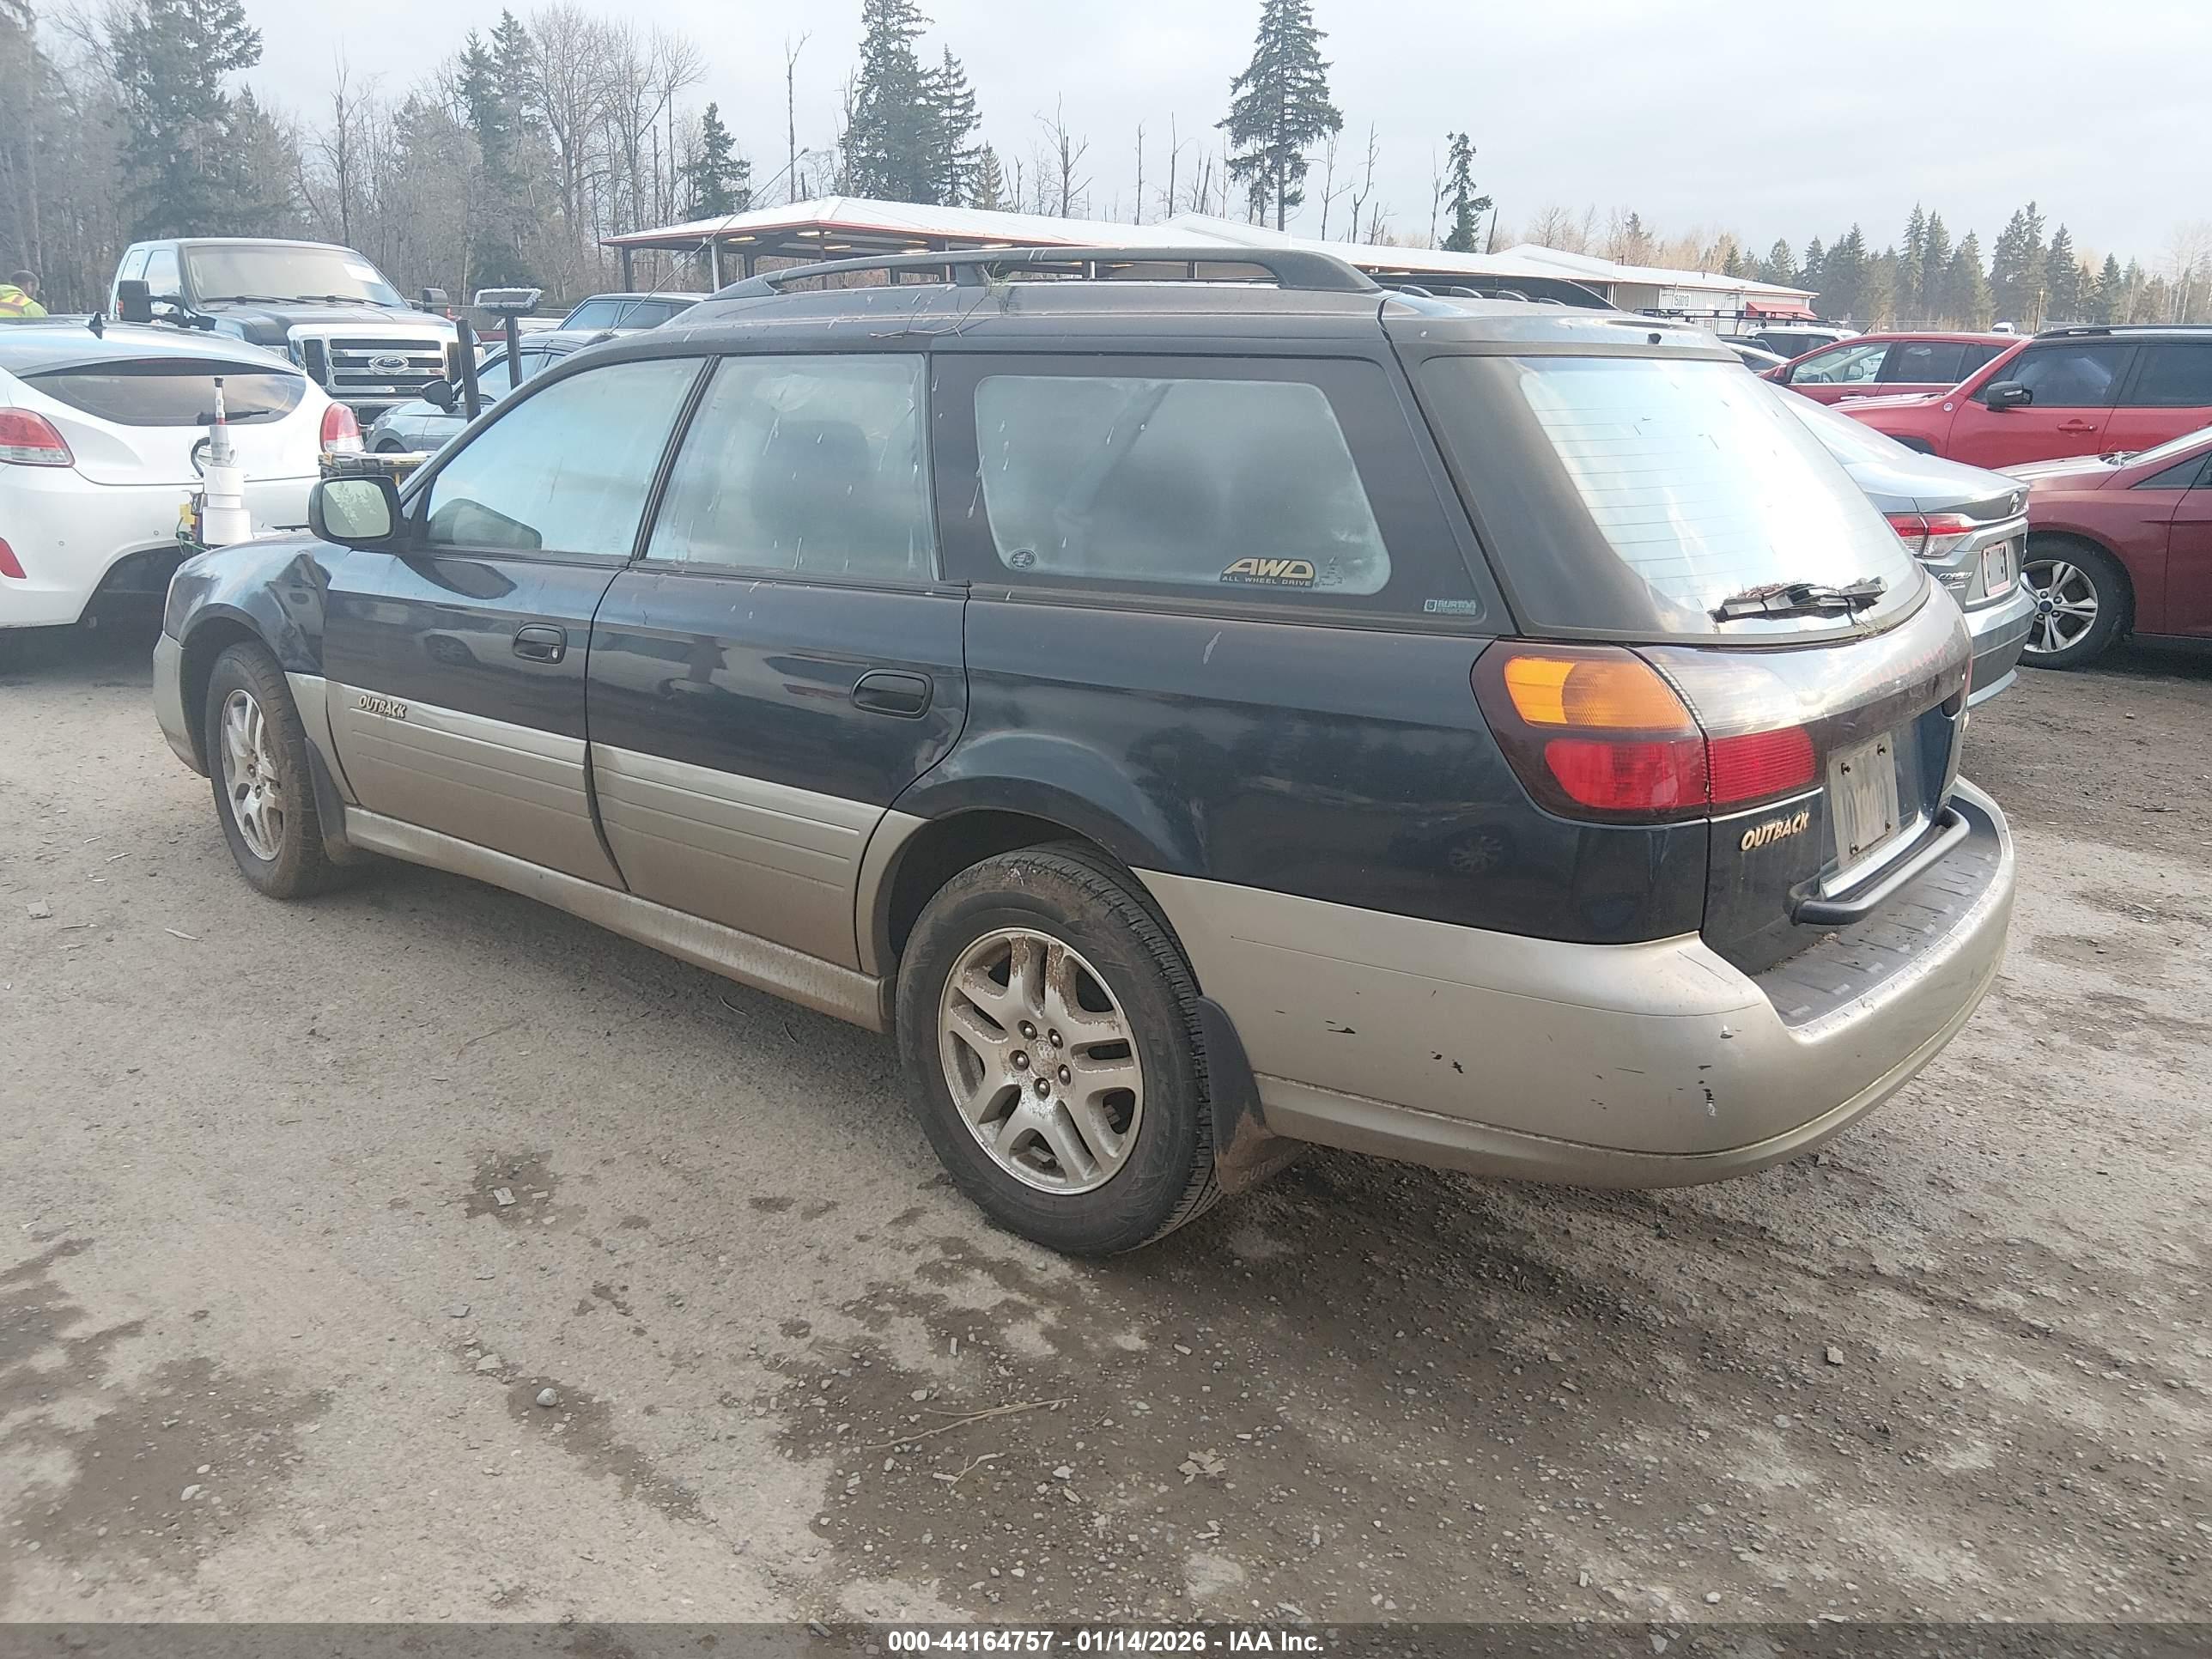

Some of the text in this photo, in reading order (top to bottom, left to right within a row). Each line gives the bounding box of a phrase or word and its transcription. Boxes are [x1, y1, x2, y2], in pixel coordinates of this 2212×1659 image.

[1222, 557, 1315, 580] AWD
[1281, 579, 1312, 587] DRIVE
[359, 694, 407, 718] OUTBACK
[1741, 811, 1809, 851] OUTBACK
